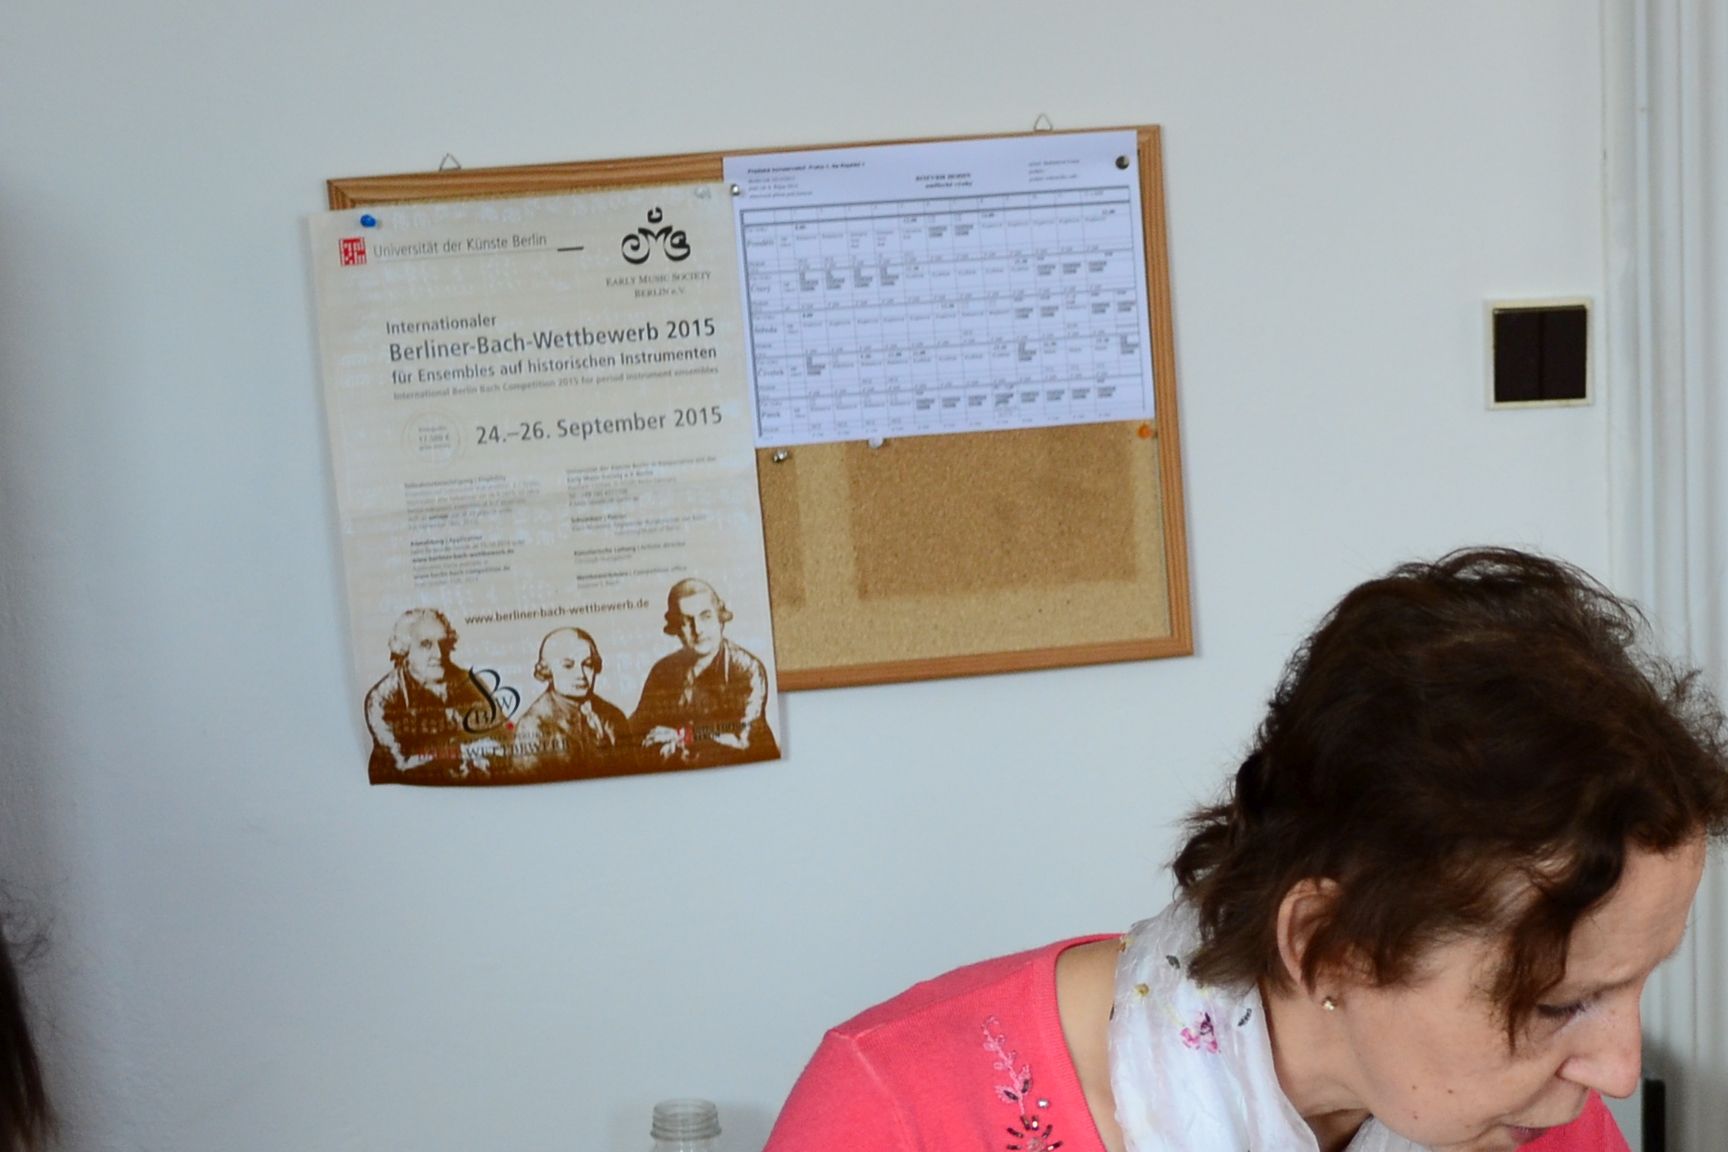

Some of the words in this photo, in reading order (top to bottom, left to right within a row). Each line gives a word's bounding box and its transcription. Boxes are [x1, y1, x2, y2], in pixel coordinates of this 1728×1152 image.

[373, 240, 439, 259] Universität
[443, 238, 464, 253] der
[467, 235, 508, 251] Künste
[512, 233, 547, 248] Berlin
[605, 276, 636, 287] EARLY
[638, 273, 668, 284] MUSIC
[386, 313, 496, 335] Internationaler
[389, 322, 658, 362] Berliner-Bach-Wettbewerb
[667, 318, 716, 340] 2015
[391, 369, 414, 386] für
[418, 361, 495, 383] Ensembles
[500, 359, 523, 376] auf
[528, 351, 616, 373] historischen
[621, 346, 717, 367] Instrumenten
[557, 412, 666, 442] September
[674, 405, 723, 428] 2015
[464, 598, 650, 625] www.berliner-bach-wettbewerb.de
